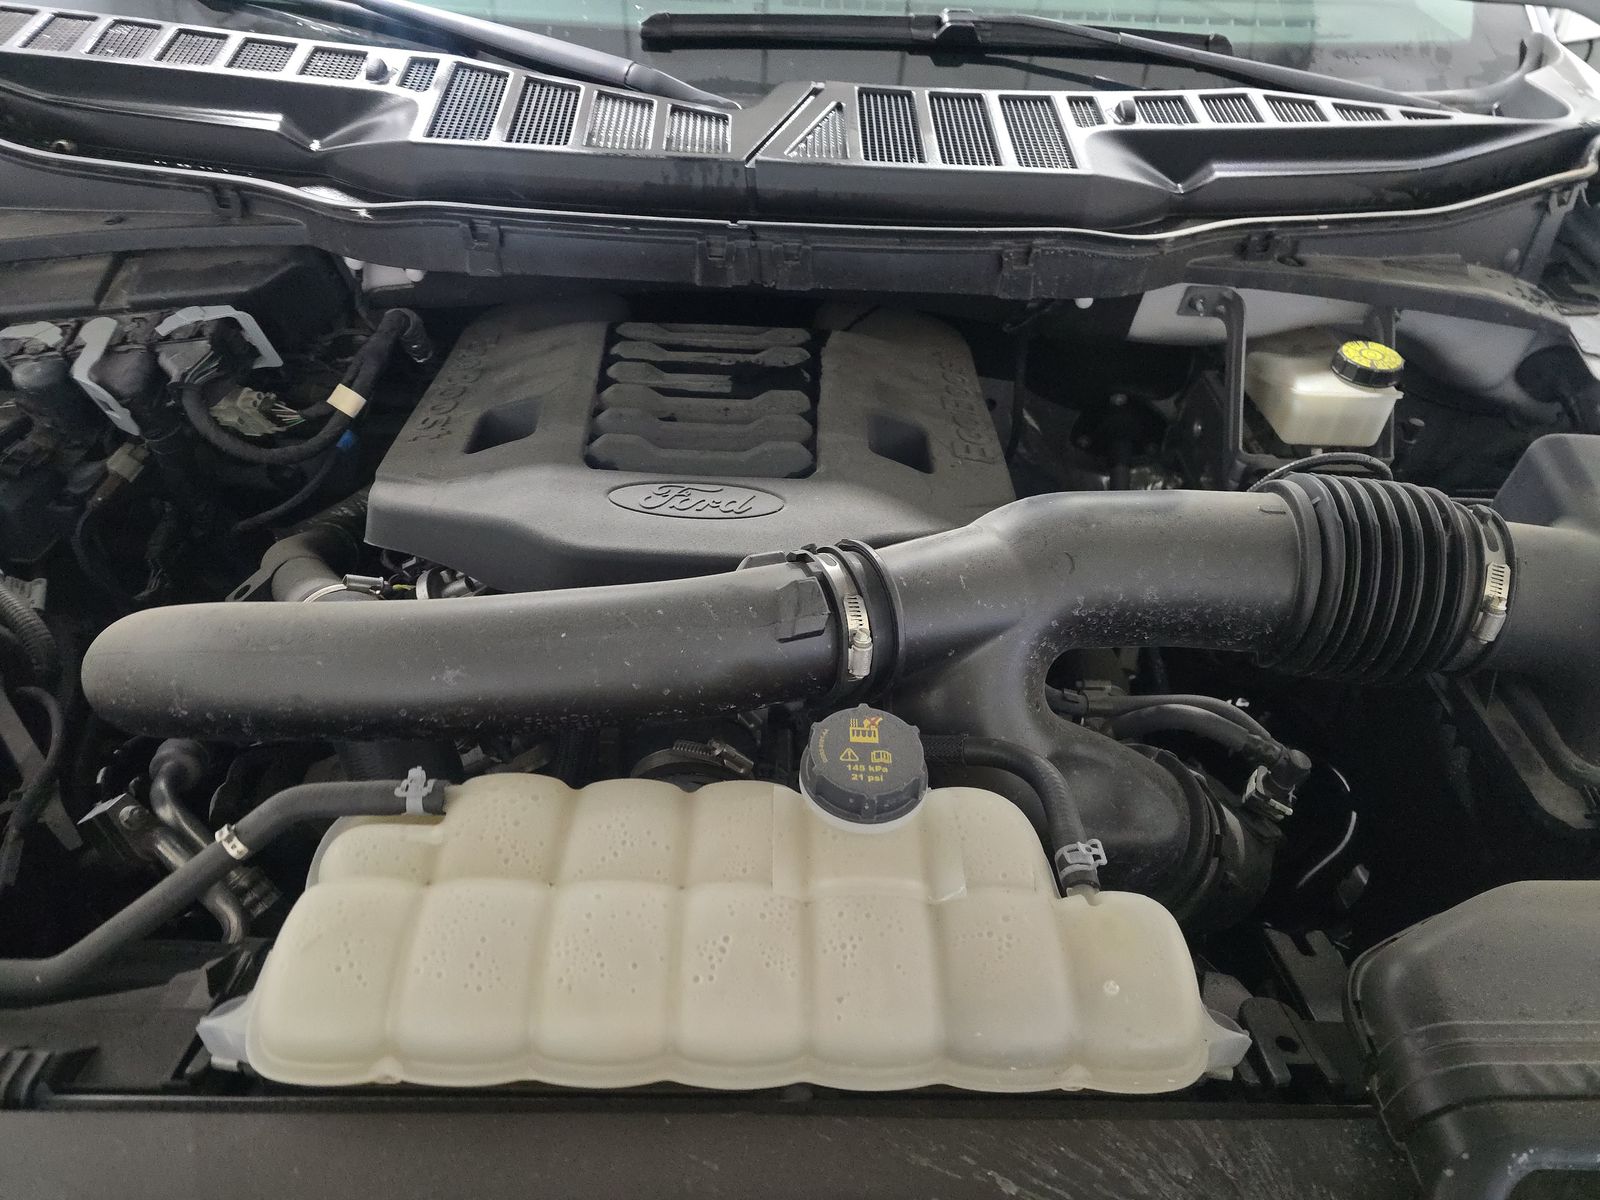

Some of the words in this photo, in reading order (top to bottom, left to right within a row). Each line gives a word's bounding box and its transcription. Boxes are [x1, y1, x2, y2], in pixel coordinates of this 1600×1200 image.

[639, 484, 756, 515] Ford
[847, 764, 865, 772] 145
[868, 765, 888, 773] kPa
[851, 773, 864, 781] 21
[867, 774, 883, 783] psi
